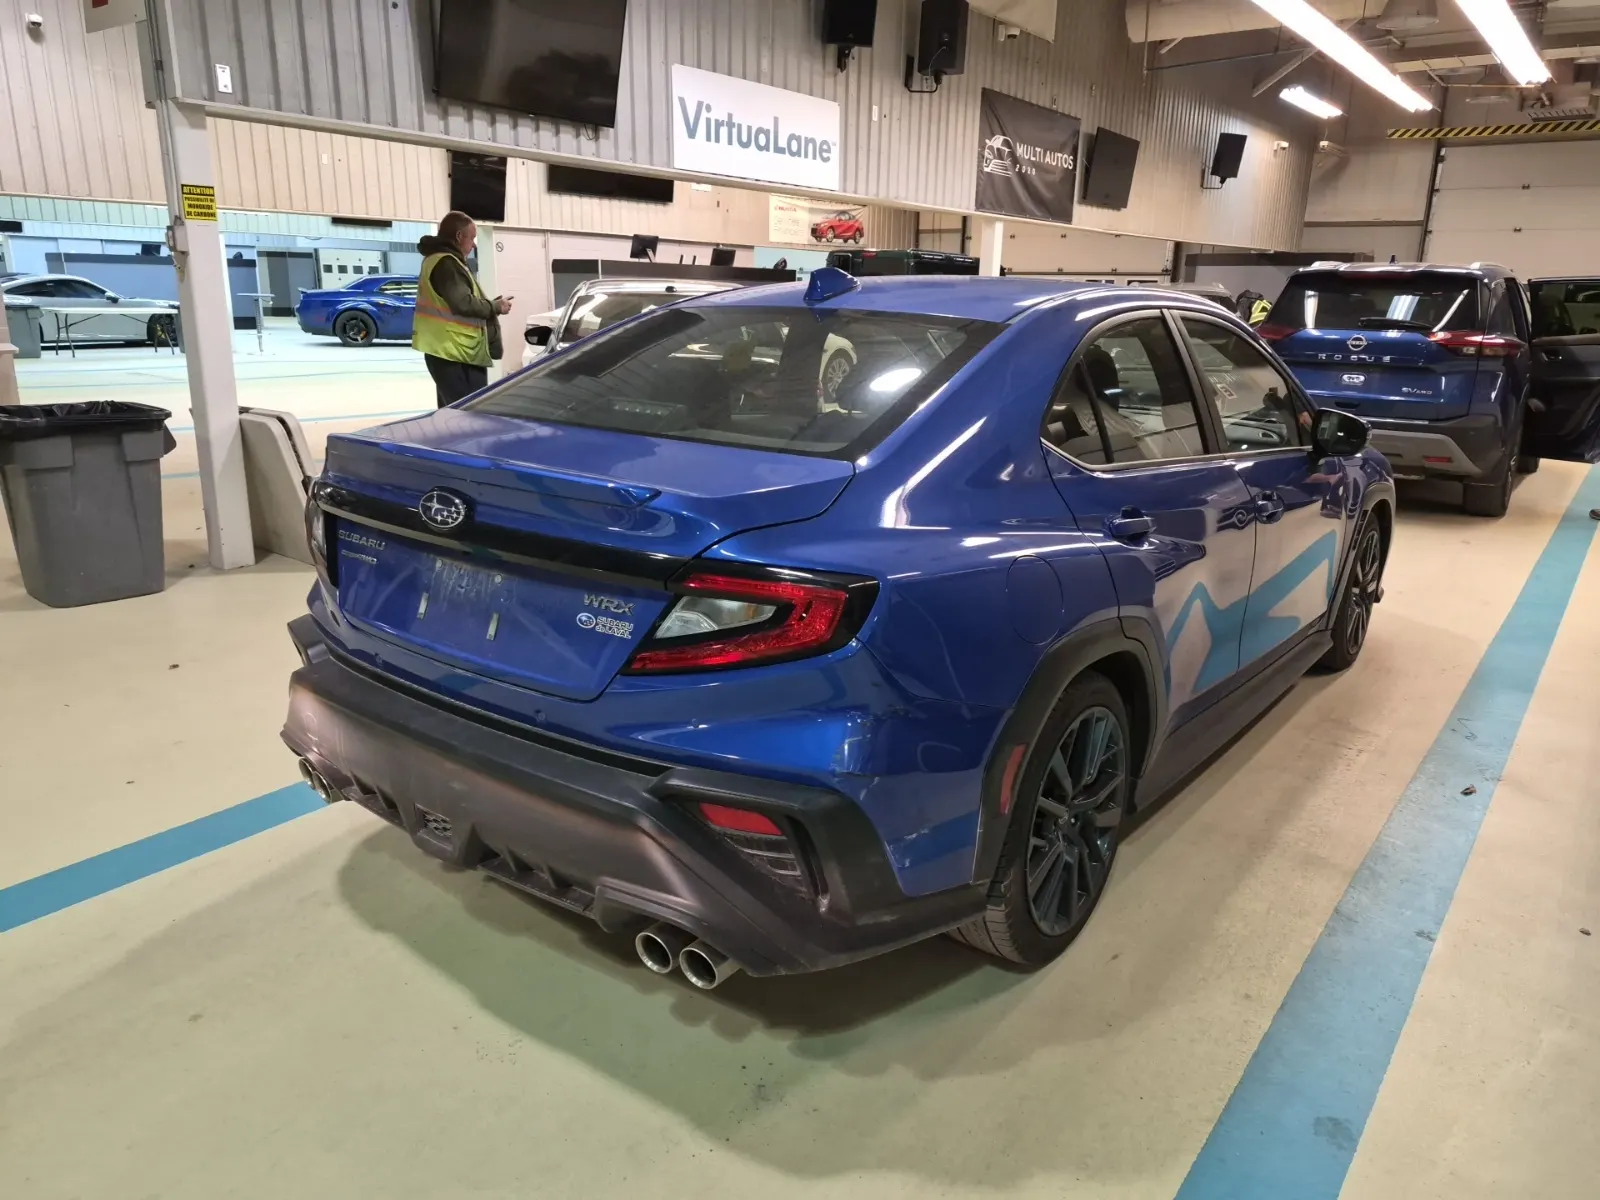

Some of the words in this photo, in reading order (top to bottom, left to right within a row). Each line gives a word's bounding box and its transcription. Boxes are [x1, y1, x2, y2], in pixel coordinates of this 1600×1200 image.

[678, 96, 832, 163] VirtuaLane
[1016, 142, 1044, 163] MULTI
[1044, 150, 1074, 169] AUTOS
[1015, 164, 1036, 175] 2020
[182, 186, 214, 195] ATTENTION
[1318, 353, 1391, 363] ROGUE
[338, 530, 386, 551] SUBARU
[584, 594, 636, 616] WRX
[597, 616, 634, 632] SUBARU
[605, 626, 632, 639] LAVAL
